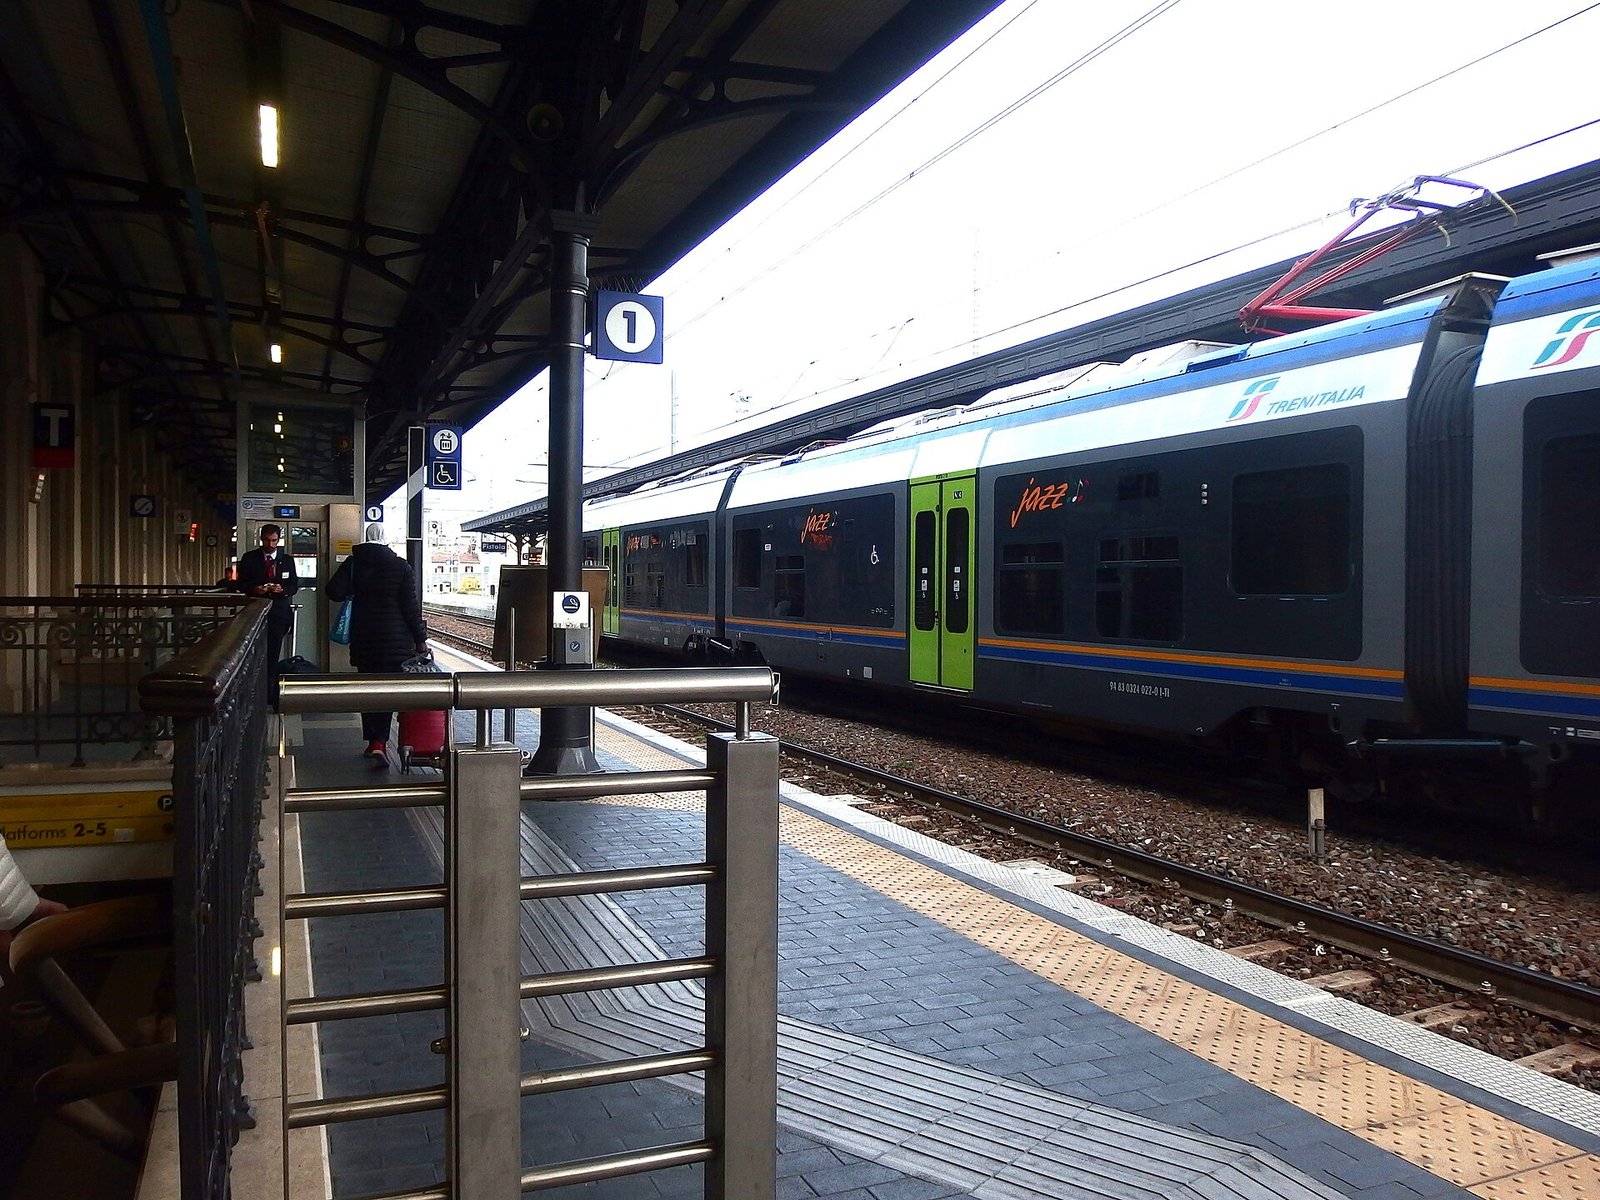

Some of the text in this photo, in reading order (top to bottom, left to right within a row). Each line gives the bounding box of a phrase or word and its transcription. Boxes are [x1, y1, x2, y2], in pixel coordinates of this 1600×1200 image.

[622, 310, 637, 344] 1
[1266, 385, 1366, 416] TRENITALIA
[40, 408, 69, 447] T
[1010, 477, 1069, 528] jazz
[800, 507, 832, 544] jazz
[1109, 681, 1117, 691] 94
[1117, 682, 1125, 692] 83
[1126, 683, 1140, 694] 0324
[163, 797, 173, 810] P
[0, 822, 107, 841] latforms 2-5
